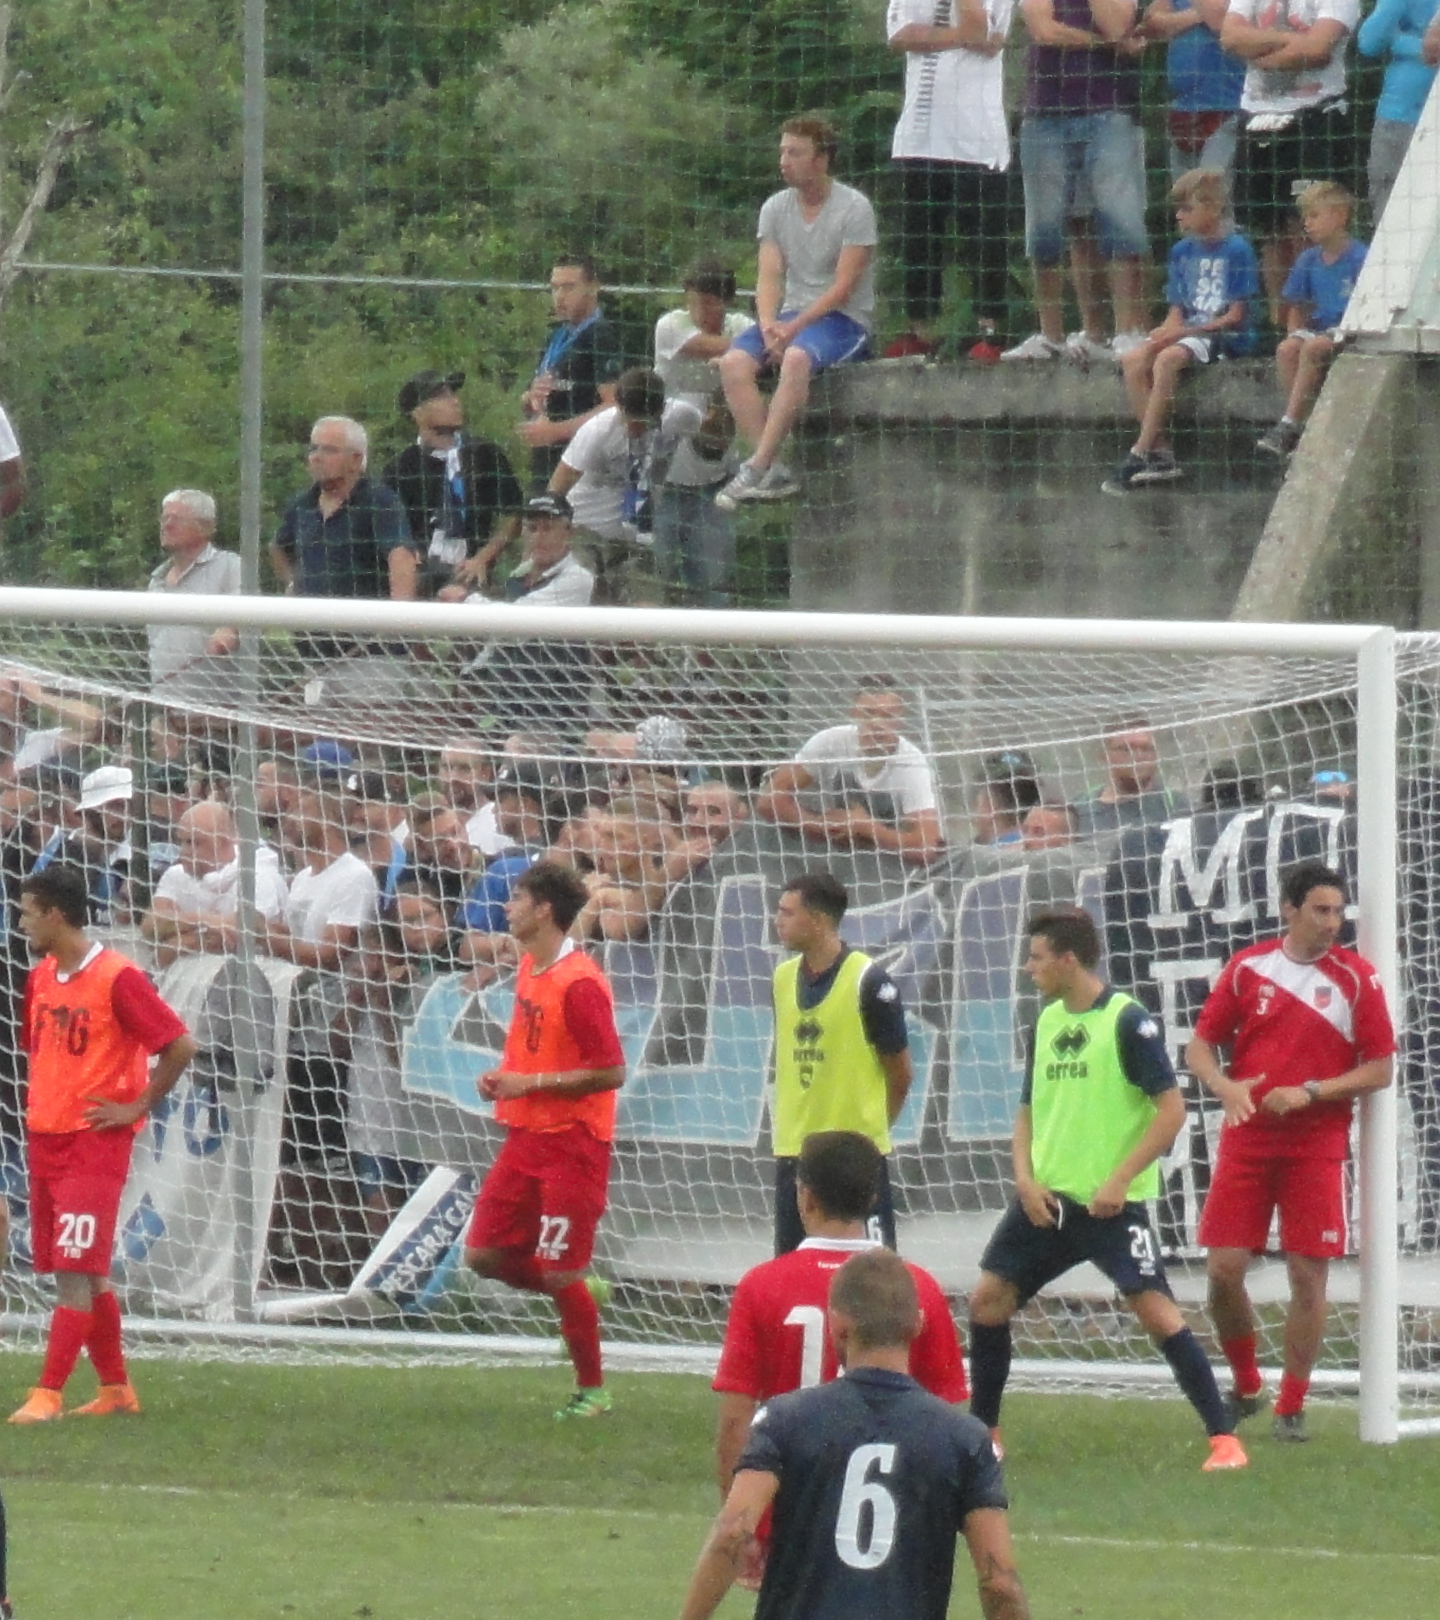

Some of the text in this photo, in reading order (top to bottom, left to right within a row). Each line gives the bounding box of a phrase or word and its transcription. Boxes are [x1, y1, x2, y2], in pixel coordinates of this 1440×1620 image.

[56, 1212, 96, 1249] 20
[1128, 1225, 1155, 1261] 21
[835, 1442, 898, 1571] 6
